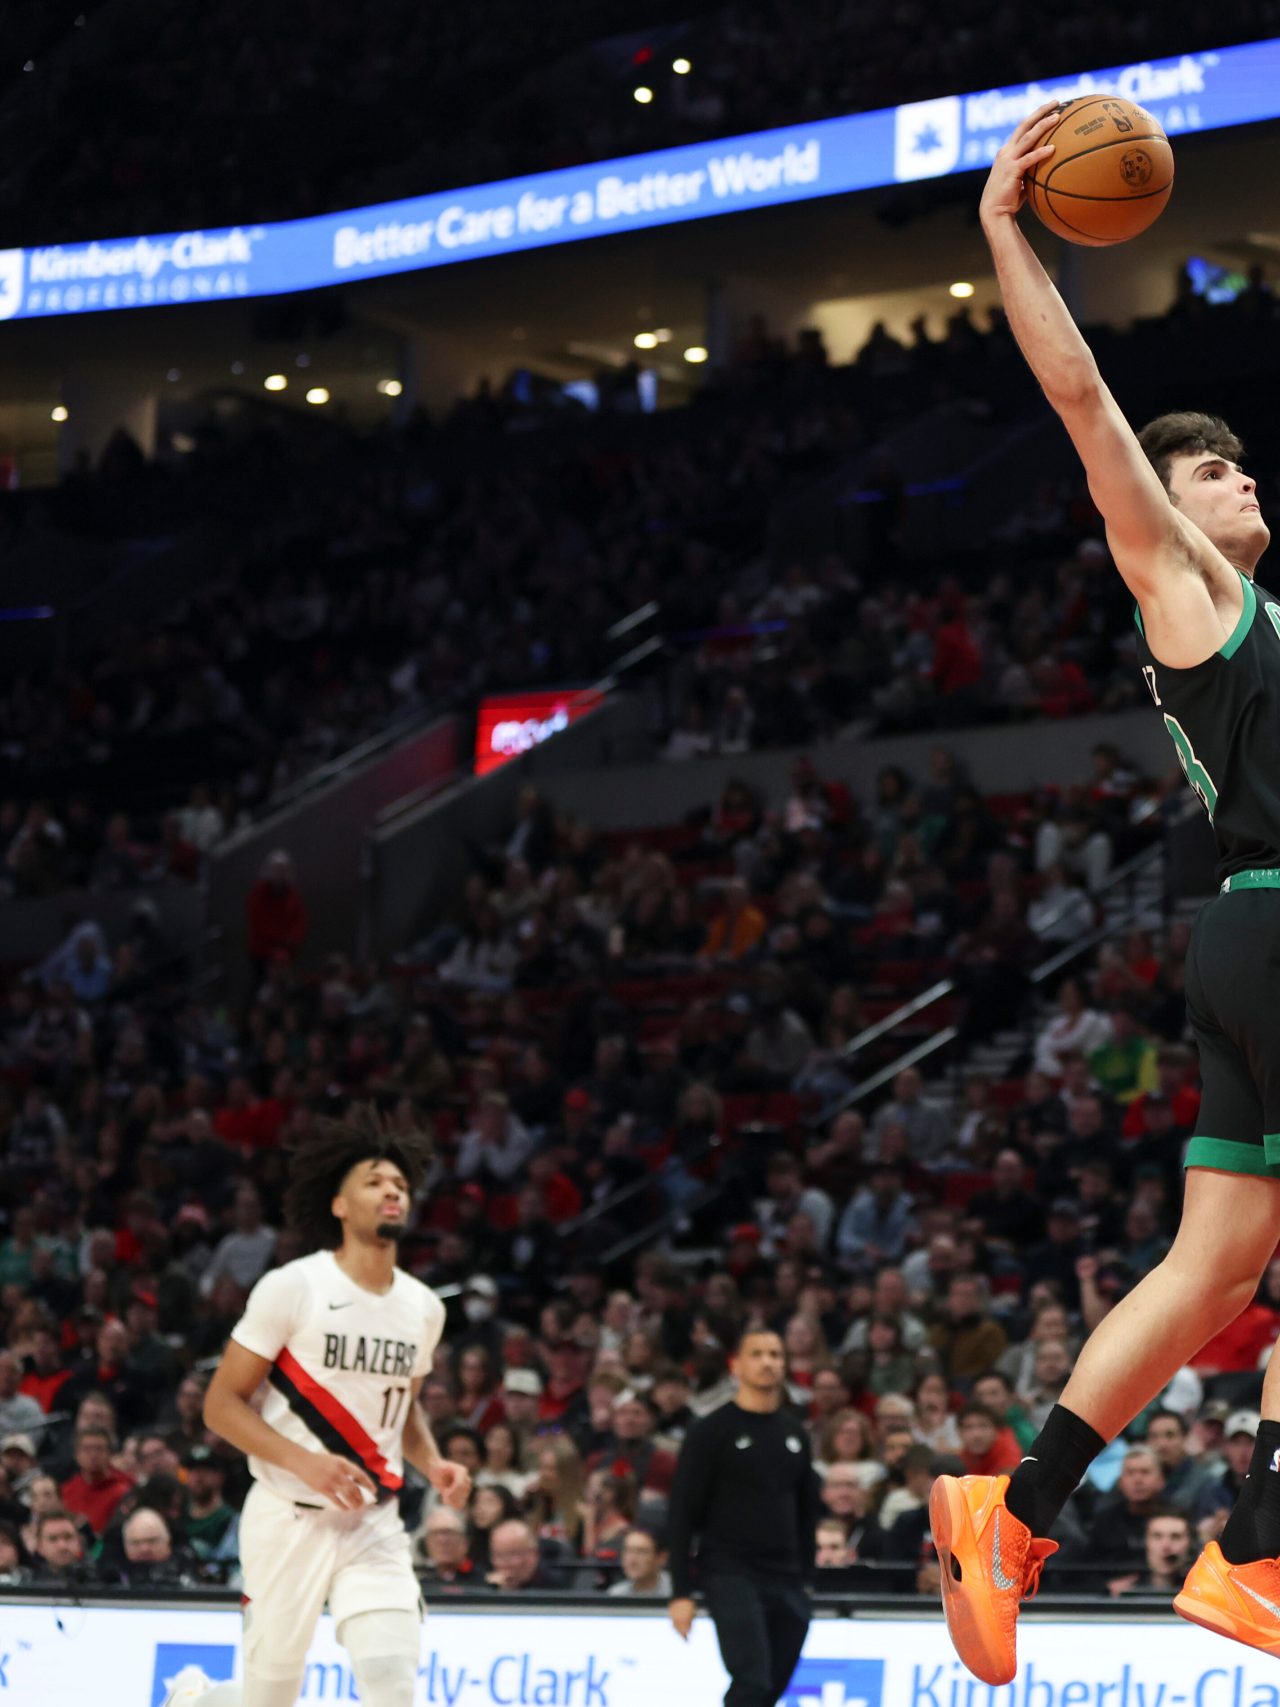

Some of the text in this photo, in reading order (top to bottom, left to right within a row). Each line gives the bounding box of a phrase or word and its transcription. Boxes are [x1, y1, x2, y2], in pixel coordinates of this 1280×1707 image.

[333, 138, 821, 269] Better Care for a Better World
[30, 226, 252, 282] Kimberly-Clark
[323, 1333, 418, 1378] BLAZERS
[381, 1386, 406, 1430] 17
[300, 1650, 611, 1707] mly-Clark
